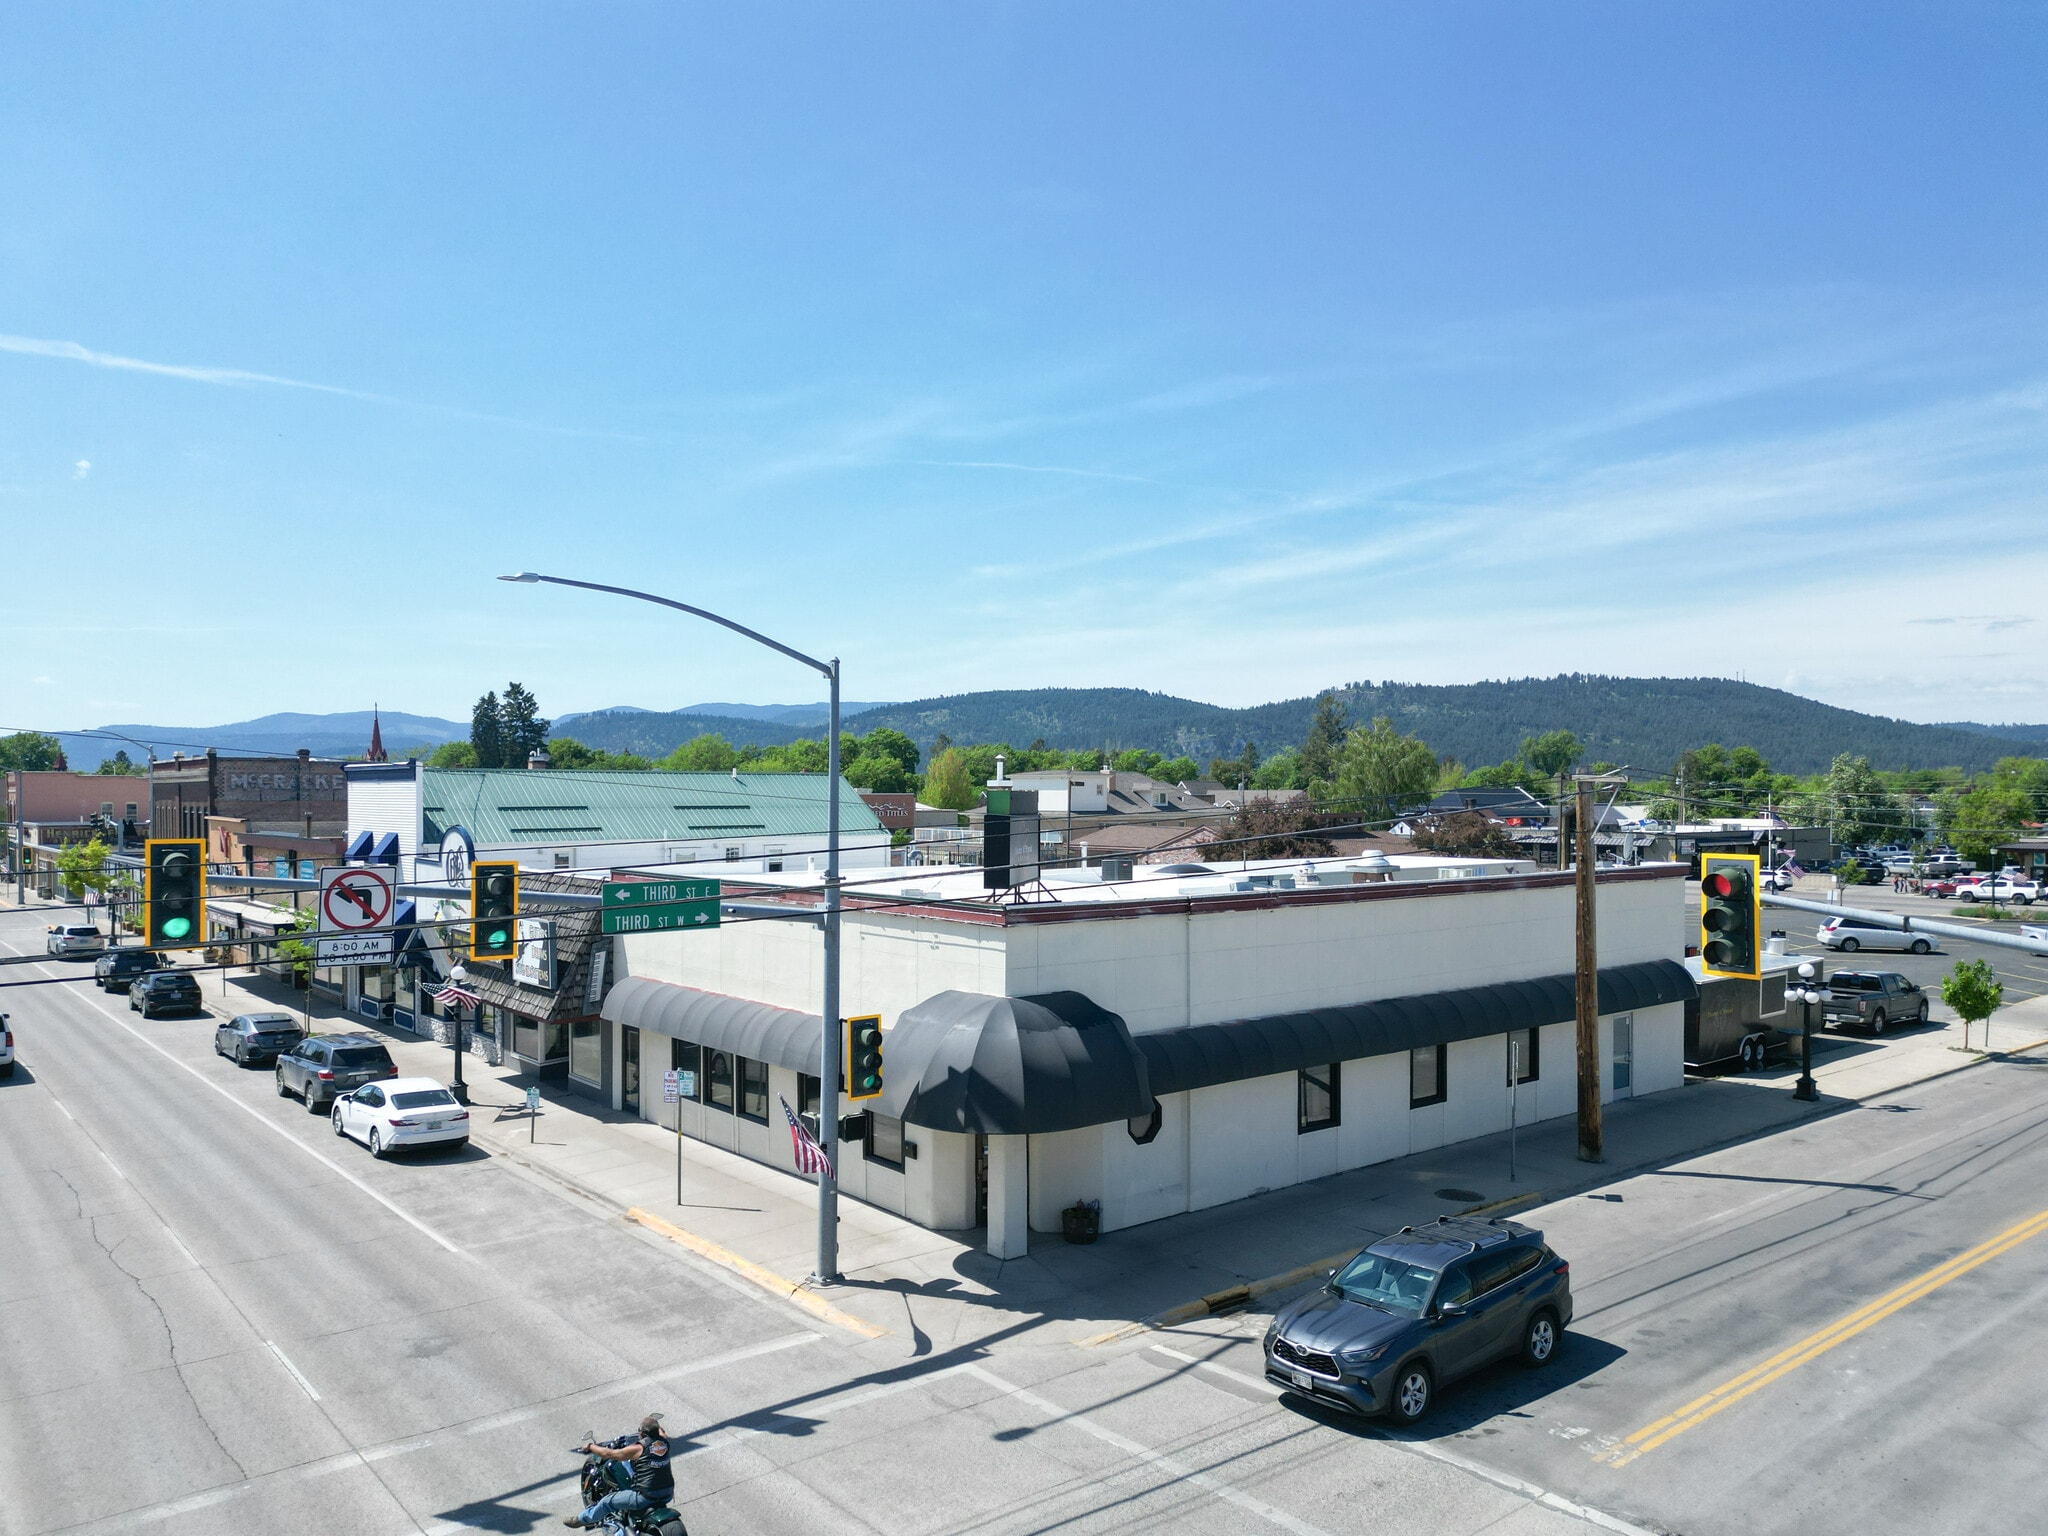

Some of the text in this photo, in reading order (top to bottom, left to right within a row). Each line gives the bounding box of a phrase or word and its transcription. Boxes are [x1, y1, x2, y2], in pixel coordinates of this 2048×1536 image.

[643, 885, 710, 901] THIRD ST E
[615, 914, 685, 931] THIRD ST W
[363, 941, 379, 950] AM
[323, 953, 336, 963] TO
